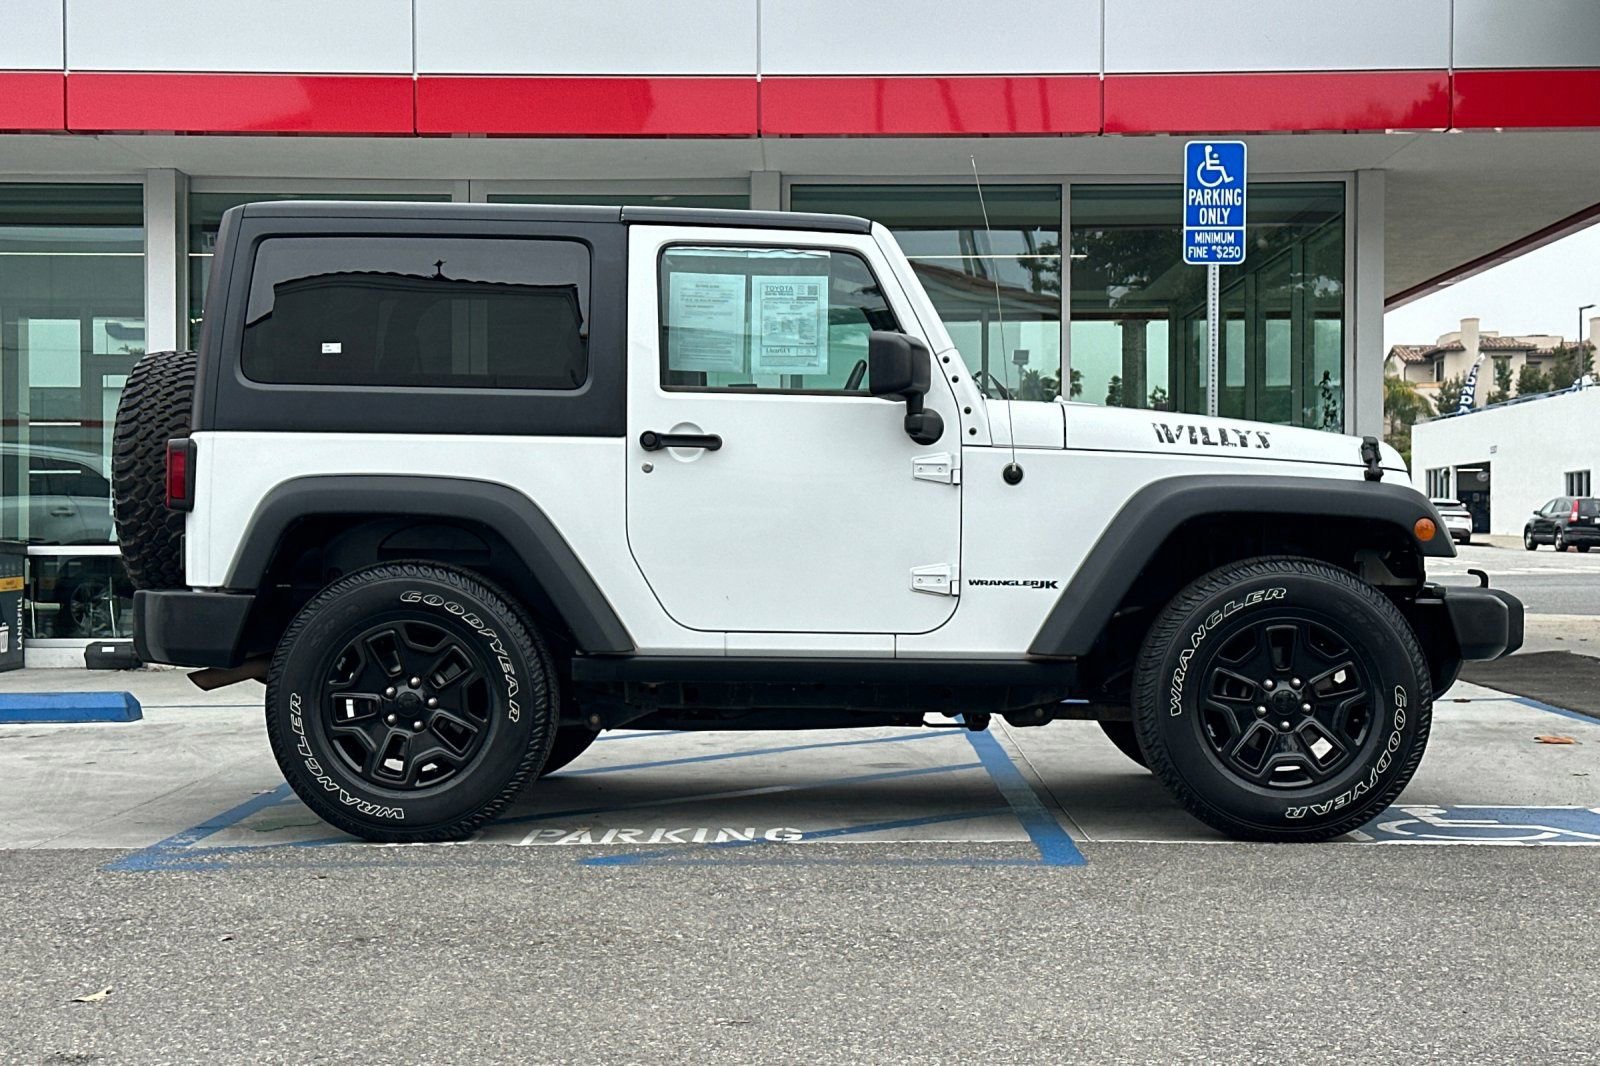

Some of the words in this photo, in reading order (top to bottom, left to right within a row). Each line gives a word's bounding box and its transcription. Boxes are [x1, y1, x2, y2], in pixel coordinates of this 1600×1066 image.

[1188, 188, 1242, 206] PARKING
[1199, 207, 1231, 225] ONLY
[1194, 231, 1235, 244] MINIMUM
[1187, 246, 1209, 258] FINE
[1216, 246, 1241, 260] $250
[1151, 422, 1271, 449] WILLYS
[399, 590, 521, 723] GOODYEAR
[1170, 587, 1287, 717] WRANGLER
[290, 692, 406, 820] WRANGLER
[1285, 685, 1408, 819] GOODYEAR
[518, 827, 803, 845] PARKING
